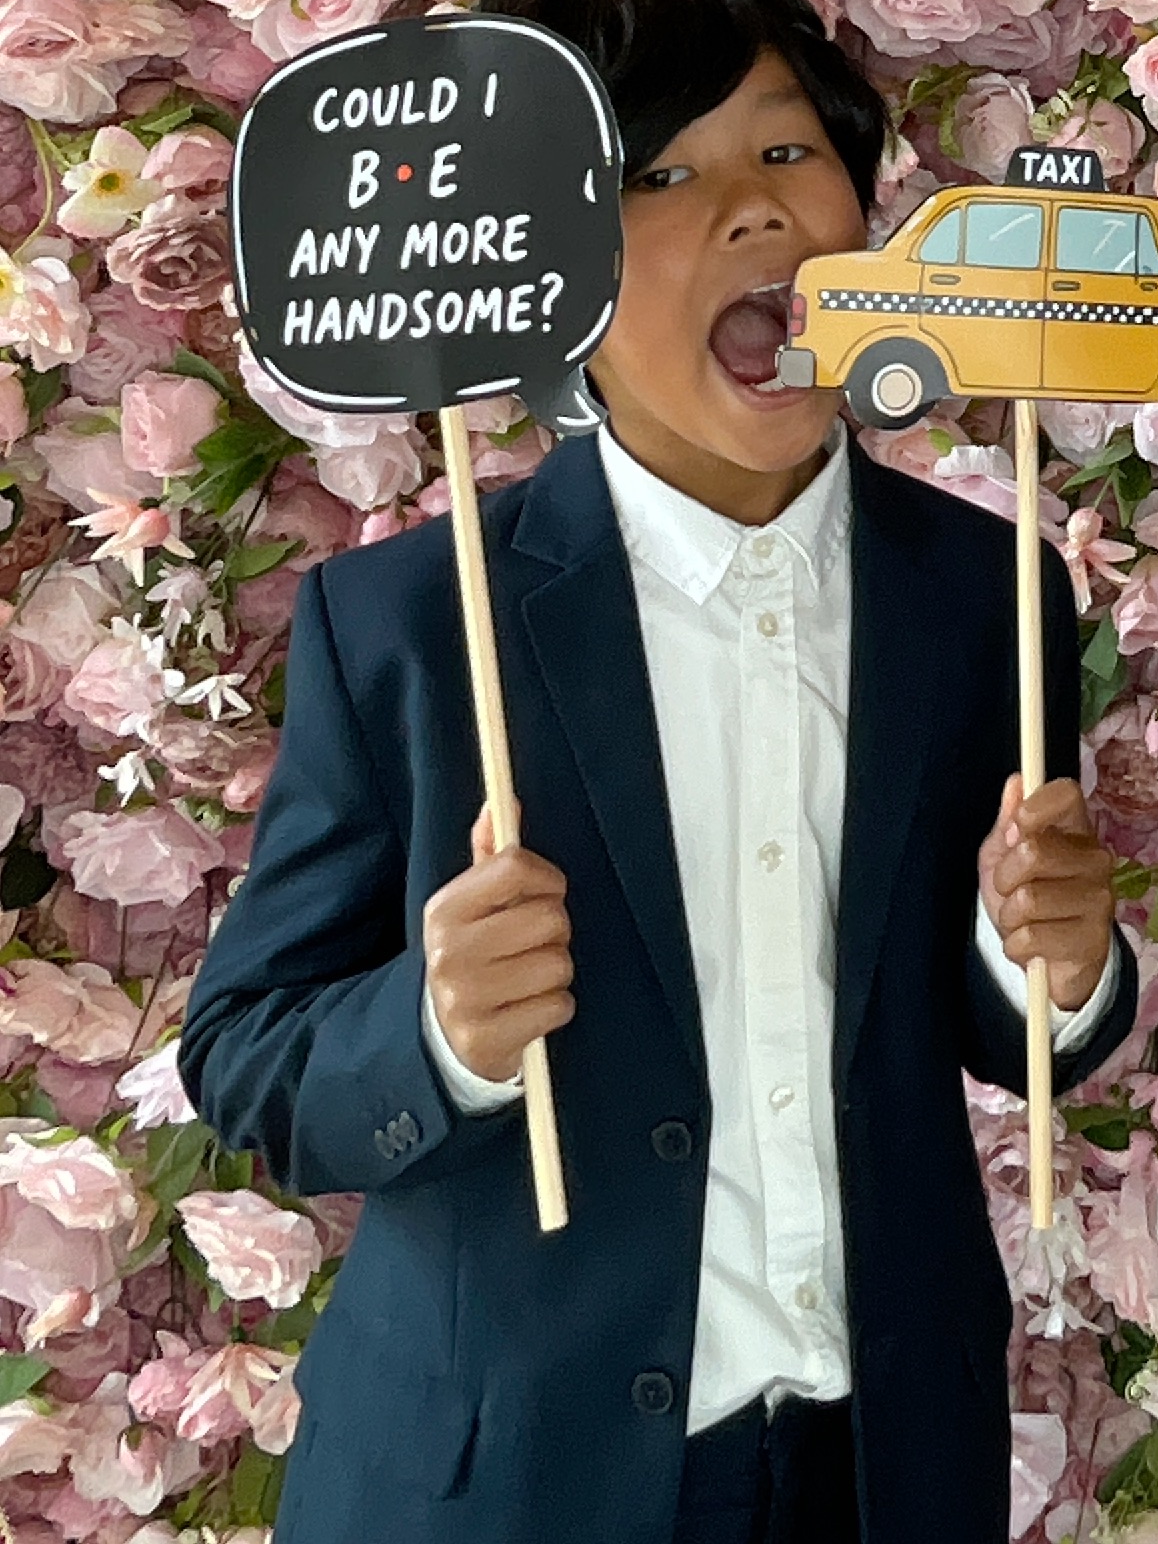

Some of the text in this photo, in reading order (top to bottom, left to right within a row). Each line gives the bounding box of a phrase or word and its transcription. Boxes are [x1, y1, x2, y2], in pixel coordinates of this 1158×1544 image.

[313, 72, 498, 133] COULD I
[1019, 152, 1093, 186] TAXI
[289, 213, 532, 279] ANY MORE
[283, 272, 565, 347] HANDSOME?
